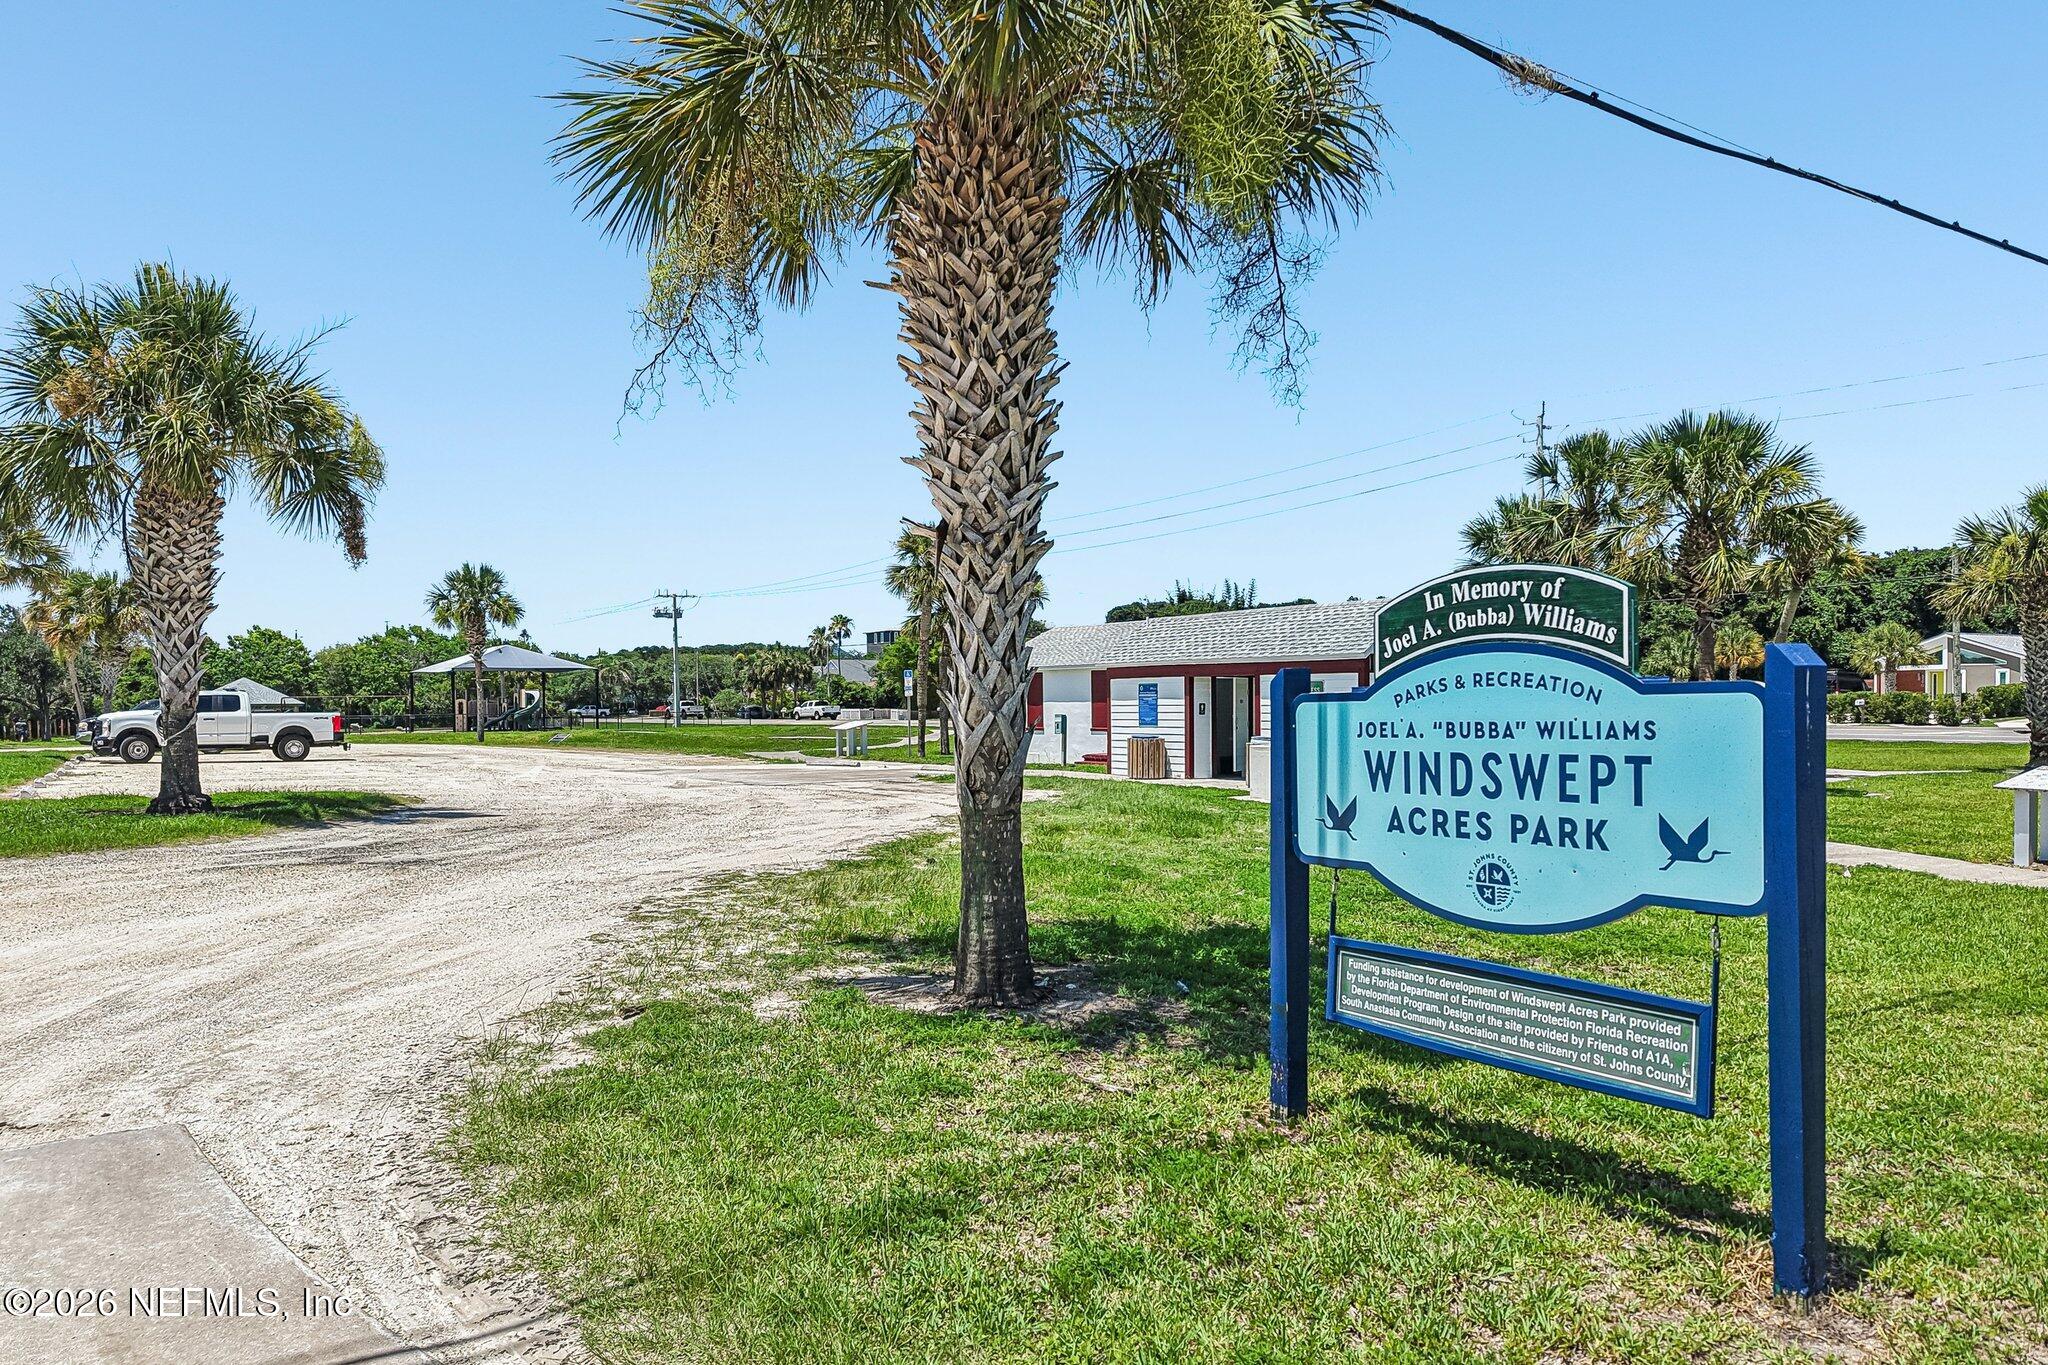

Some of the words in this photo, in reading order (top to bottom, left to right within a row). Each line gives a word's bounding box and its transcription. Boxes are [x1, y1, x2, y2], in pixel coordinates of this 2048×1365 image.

[1423, 591, 1445, 613] In
[1451, 579, 1534, 603] Memory
[1540, 577, 1566, 600] of
[1382, 625, 1418, 659] Joel
[1422, 618, 1443, 640] A.
[1448, 604, 1515, 633] (Bubba)
[1522, 603, 1618, 645] Williams
[1393, 677, 1448, 709] PARKS
[1454, 674, 1466, 690] &
[1473, 671, 1603, 705] RECREATION
[1357, 721, 1399, 739] JOEL
[1405, 720, 1425, 739] A.
[1432, 720, 1527, 740] "BUBBA"
[1536, 719, 1657, 741] WILLIAMS
[1363, 750, 1653, 807] WINDSWEPT
[1386, 805, 1493, 842] ACRES
[1510, 813, 1611, 852] PARK
[1467, 869, 1476, 881] ST.
[1473, 853, 1495, 868] JOHNS
[1497, 855, 1519, 886] COUNTY
[1346, 970, 1357, 984] by
[1358, 973, 1370, 985] the
[1371, 977, 1399, 991] Florida
[1400, 982, 1449, 1002] Department
[1450, 993, 1460, 1004] of
[1461, 995, 1529, 1019] Environmental
[1531, 1010, 1583, 1031] Protection
[1585, 1021, 1623, 1039] Florida
[1626, 1029, 1689, 1053] Recreation
[1348, 958, 1380, 975] Funding
[1381, 967, 1424, 983] assistance
[1425, 974, 1438, 986] for
[1439, 976, 1498, 999] development
[1499, 988, 1510, 1000] of
[1511, 991, 1566, 1013] Windswept
[1568, 1002, 1599, 1019] Acres
[1601, 1009, 1627, 1025] Park
[1629, 1016, 1682, 1037] provided
[1341, 995, 1363, 1009] South
[1363, 1000, 1400, 1018] Anastasia
[1401, 1009, 1447, 1031] Community
[1448, 1020, 1499, 1041] Association
[1500, 1033, 1518, 1046] and
[1520, 1036, 1536, 1050] the
[1536, 1042, 1578, 1062] citizenry
[1580, 1051, 1593, 1063] of
[1593, 1054, 1607, 1068] St.
[1609, 1058, 1644, 1076] Johns
[1646, 1065, 1689, 1088] County.
[1351, 984, 1402, 1005] Development
[1403, 996, 1441, 1014] Program.
[1443, 1004, 1474, 1022] Design
[1475, 1012, 1487, 1024] of
[1487, 1015, 1503, 1028] the
[1504, 1018, 1523, 1032] site
[1524, 1025, 1569, 1043] provided
[1571, 1033, 1585, 1049] by
[1587, 1037, 1629, 1057] Friends
[1631, 1048, 1644, 1061] of
[1645, 1050, 1674, 1069] A1A,
